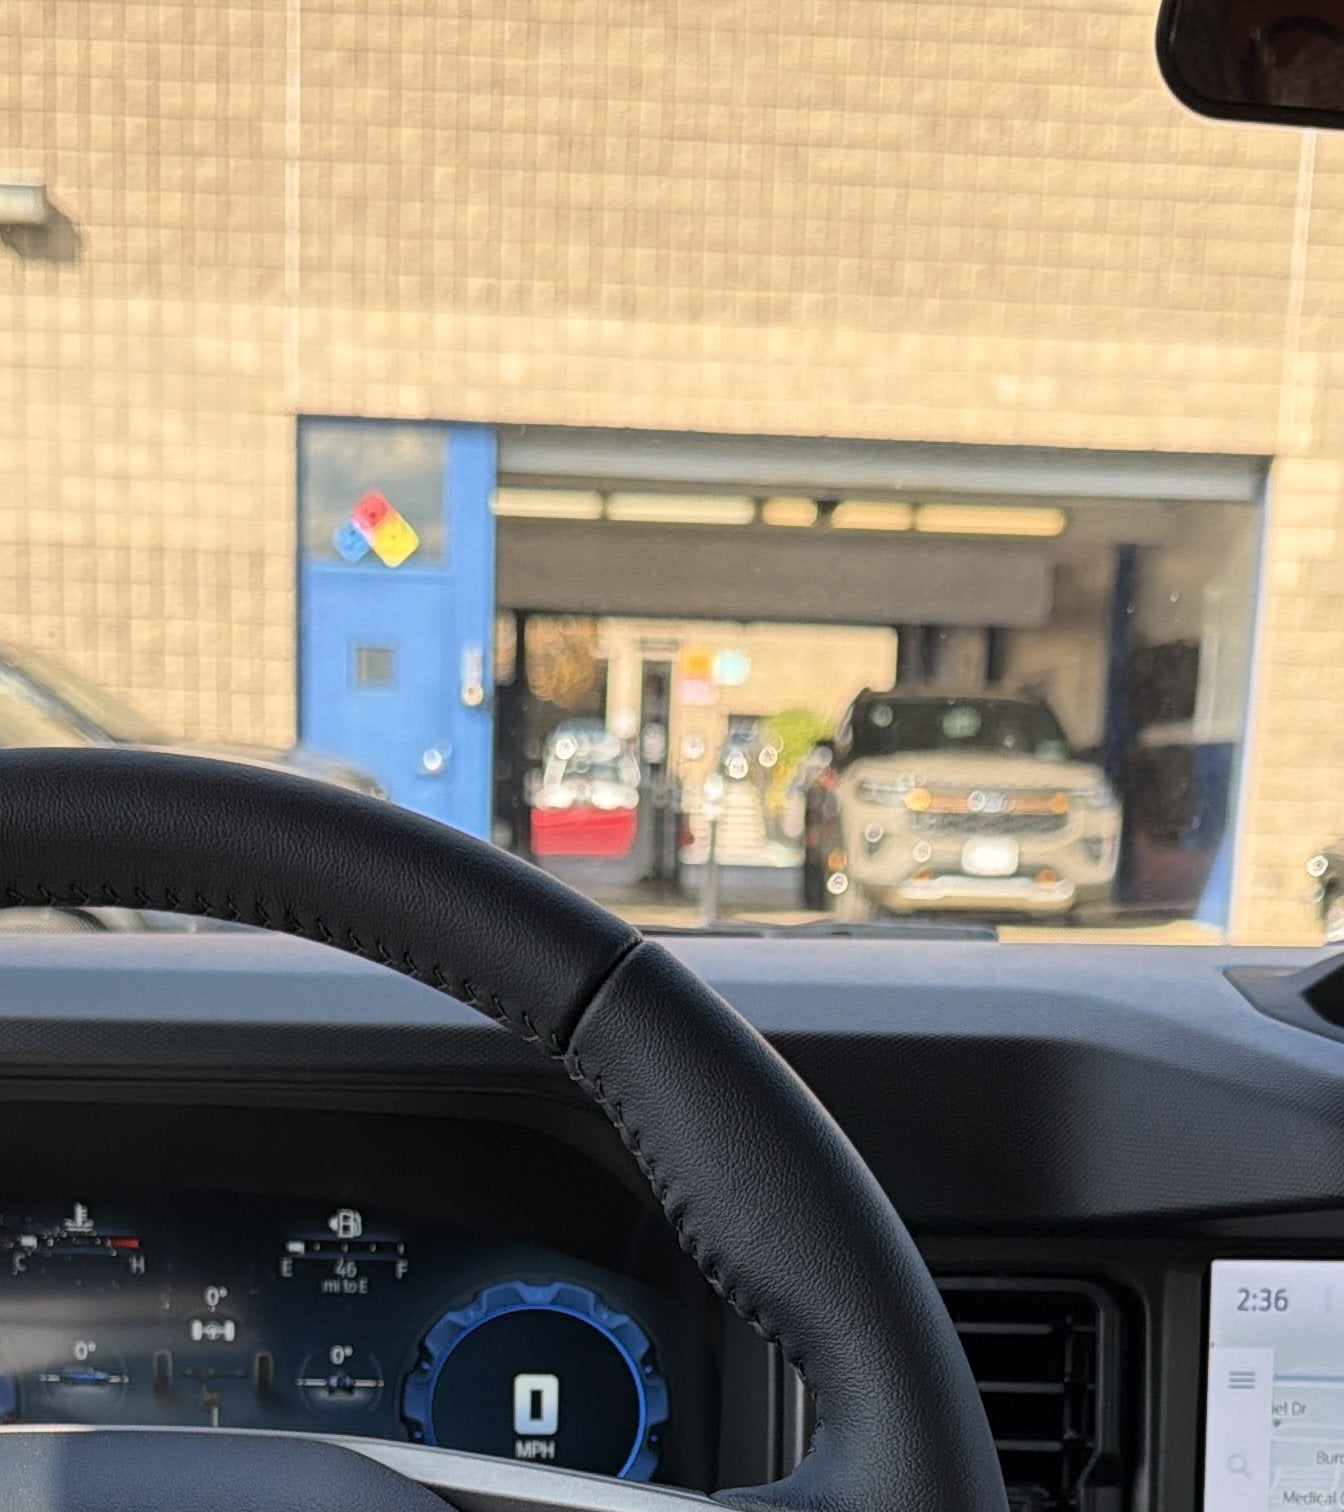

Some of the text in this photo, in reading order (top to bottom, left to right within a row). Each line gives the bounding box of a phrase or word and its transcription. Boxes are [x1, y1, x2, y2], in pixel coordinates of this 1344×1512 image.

[279, 1257, 294, 1278] E
[394, 1259, 409, 1280] F
[1236, 1287, 1289, 1312] 2:36
[513, 1373, 559, 1436] 0
[515, 1439, 555, 1459] MPH
[1282, 1490, 1337, 1505] Medical
